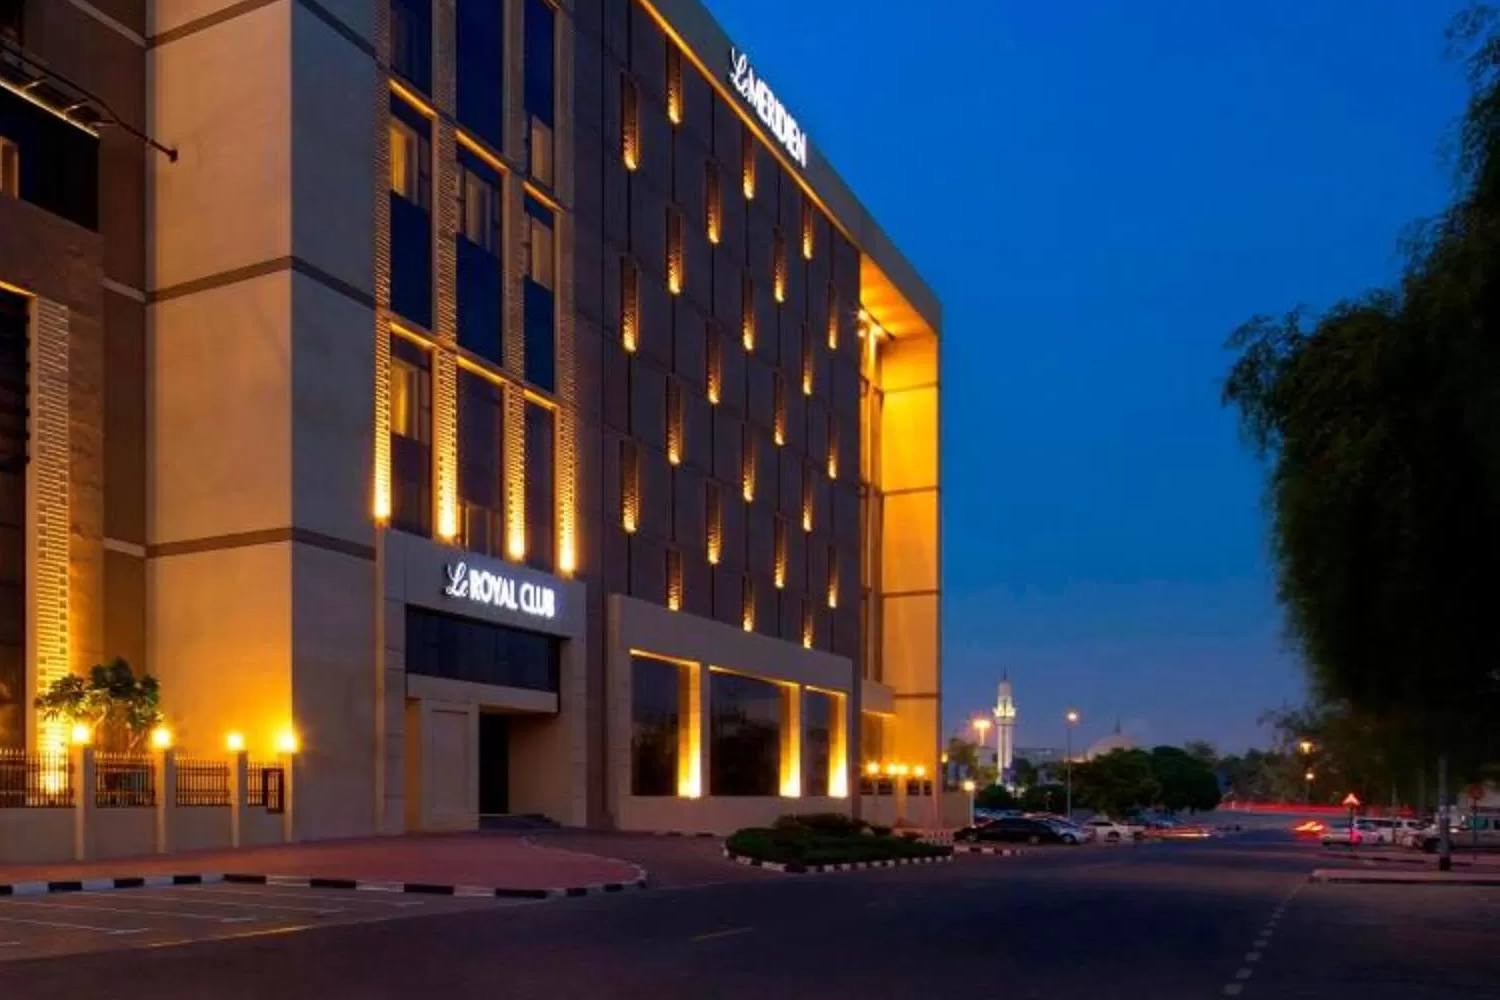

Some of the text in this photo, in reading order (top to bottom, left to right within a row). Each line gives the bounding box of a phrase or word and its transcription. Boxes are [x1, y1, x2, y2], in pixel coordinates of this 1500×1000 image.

[729, 47, 749, 97] Le
[446, 562, 555, 618] Le ROYAL CLUB
